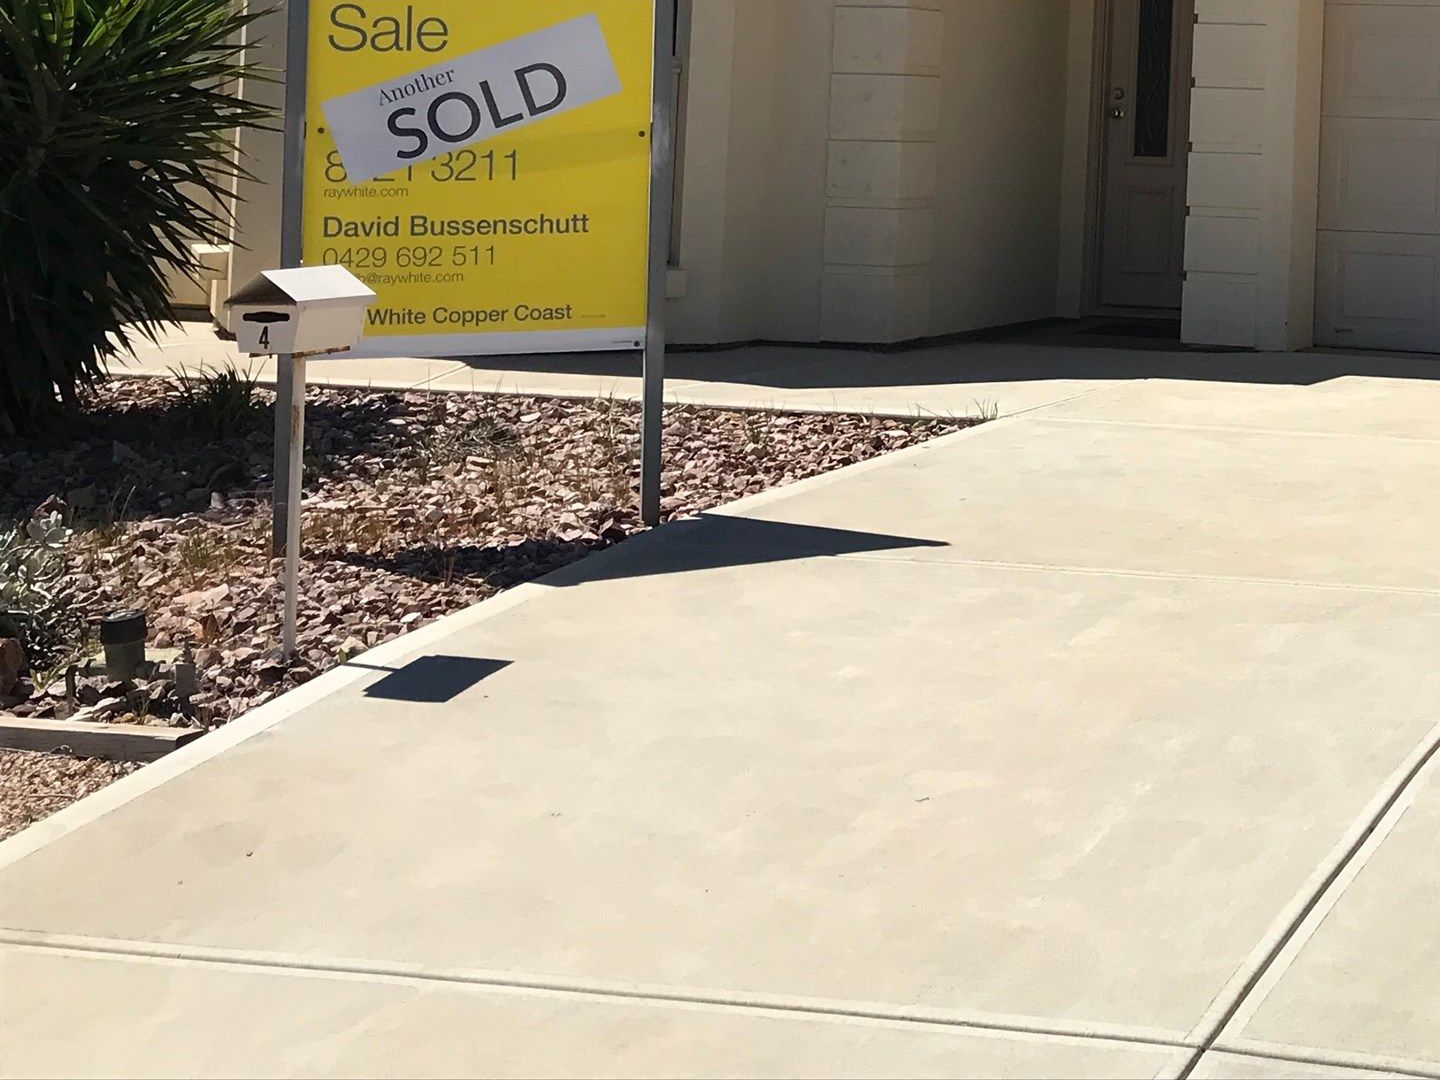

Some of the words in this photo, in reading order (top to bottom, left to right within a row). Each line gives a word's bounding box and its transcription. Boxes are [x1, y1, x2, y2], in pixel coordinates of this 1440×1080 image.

[328, 3, 449, 53] Sale
[378, 69, 455, 106] Another
[387, 62, 567, 160] SOLD
[431, 149, 517, 182] 3211
[323, 186, 409, 199] raywhite.com
[323, 216, 400, 238] David
[409, 213, 590, 236] Bussenschutt
[322, 246, 387, 268] 0429
[396, 245, 443, 267] 692
[452, 245, 496, 266] 511
[355, 272, 464, 286] b@raywhite.com
[366, 308, 427, 326] White
[432, 306, 509, 327] Copper
[513, 304, 573, 322] Coast
[258, 325, 270, 350] 4
